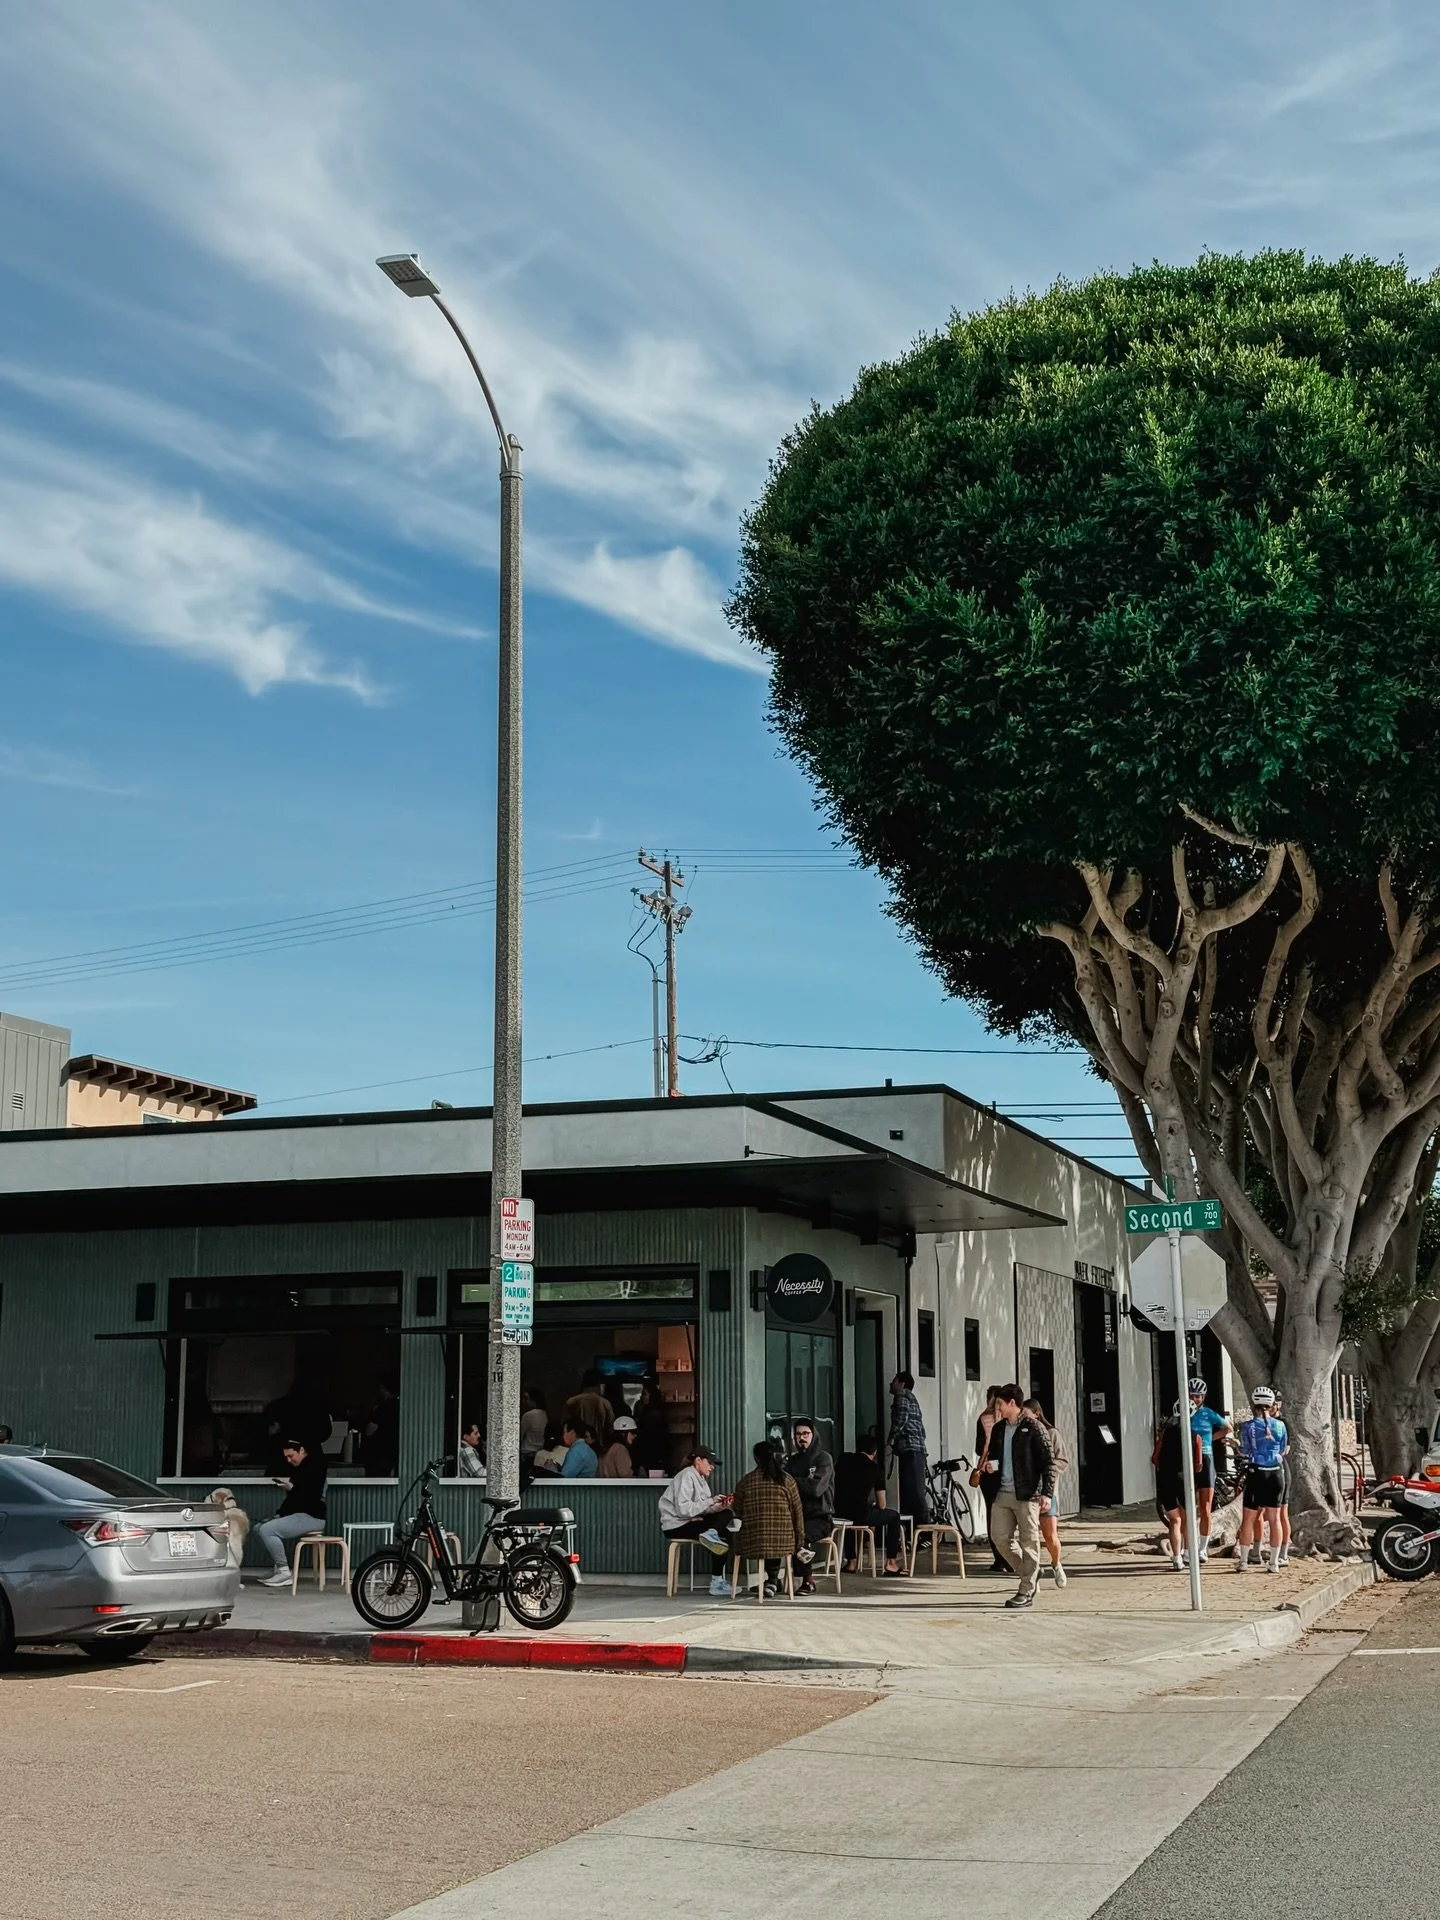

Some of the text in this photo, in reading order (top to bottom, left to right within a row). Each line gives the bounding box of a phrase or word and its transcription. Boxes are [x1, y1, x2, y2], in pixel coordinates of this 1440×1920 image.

[504, 1200, 515, 1215] NO
[1206, 1203, 1214, 1211] ST
[1128, 1206, 1193, 1230] Second
[1204, 1211, 1218, 1219] 700
[504, 1219, 531, 1232] PARKING
[506, 1232, 528, 1241] MONDAY
[505, 1266, 530, 1280] 2 HOUR
[774, 1277, 824, 1294] Necessity
[504, 1286, 531, 1299] PARKING
[496, 1353, 502, 1364] 2
